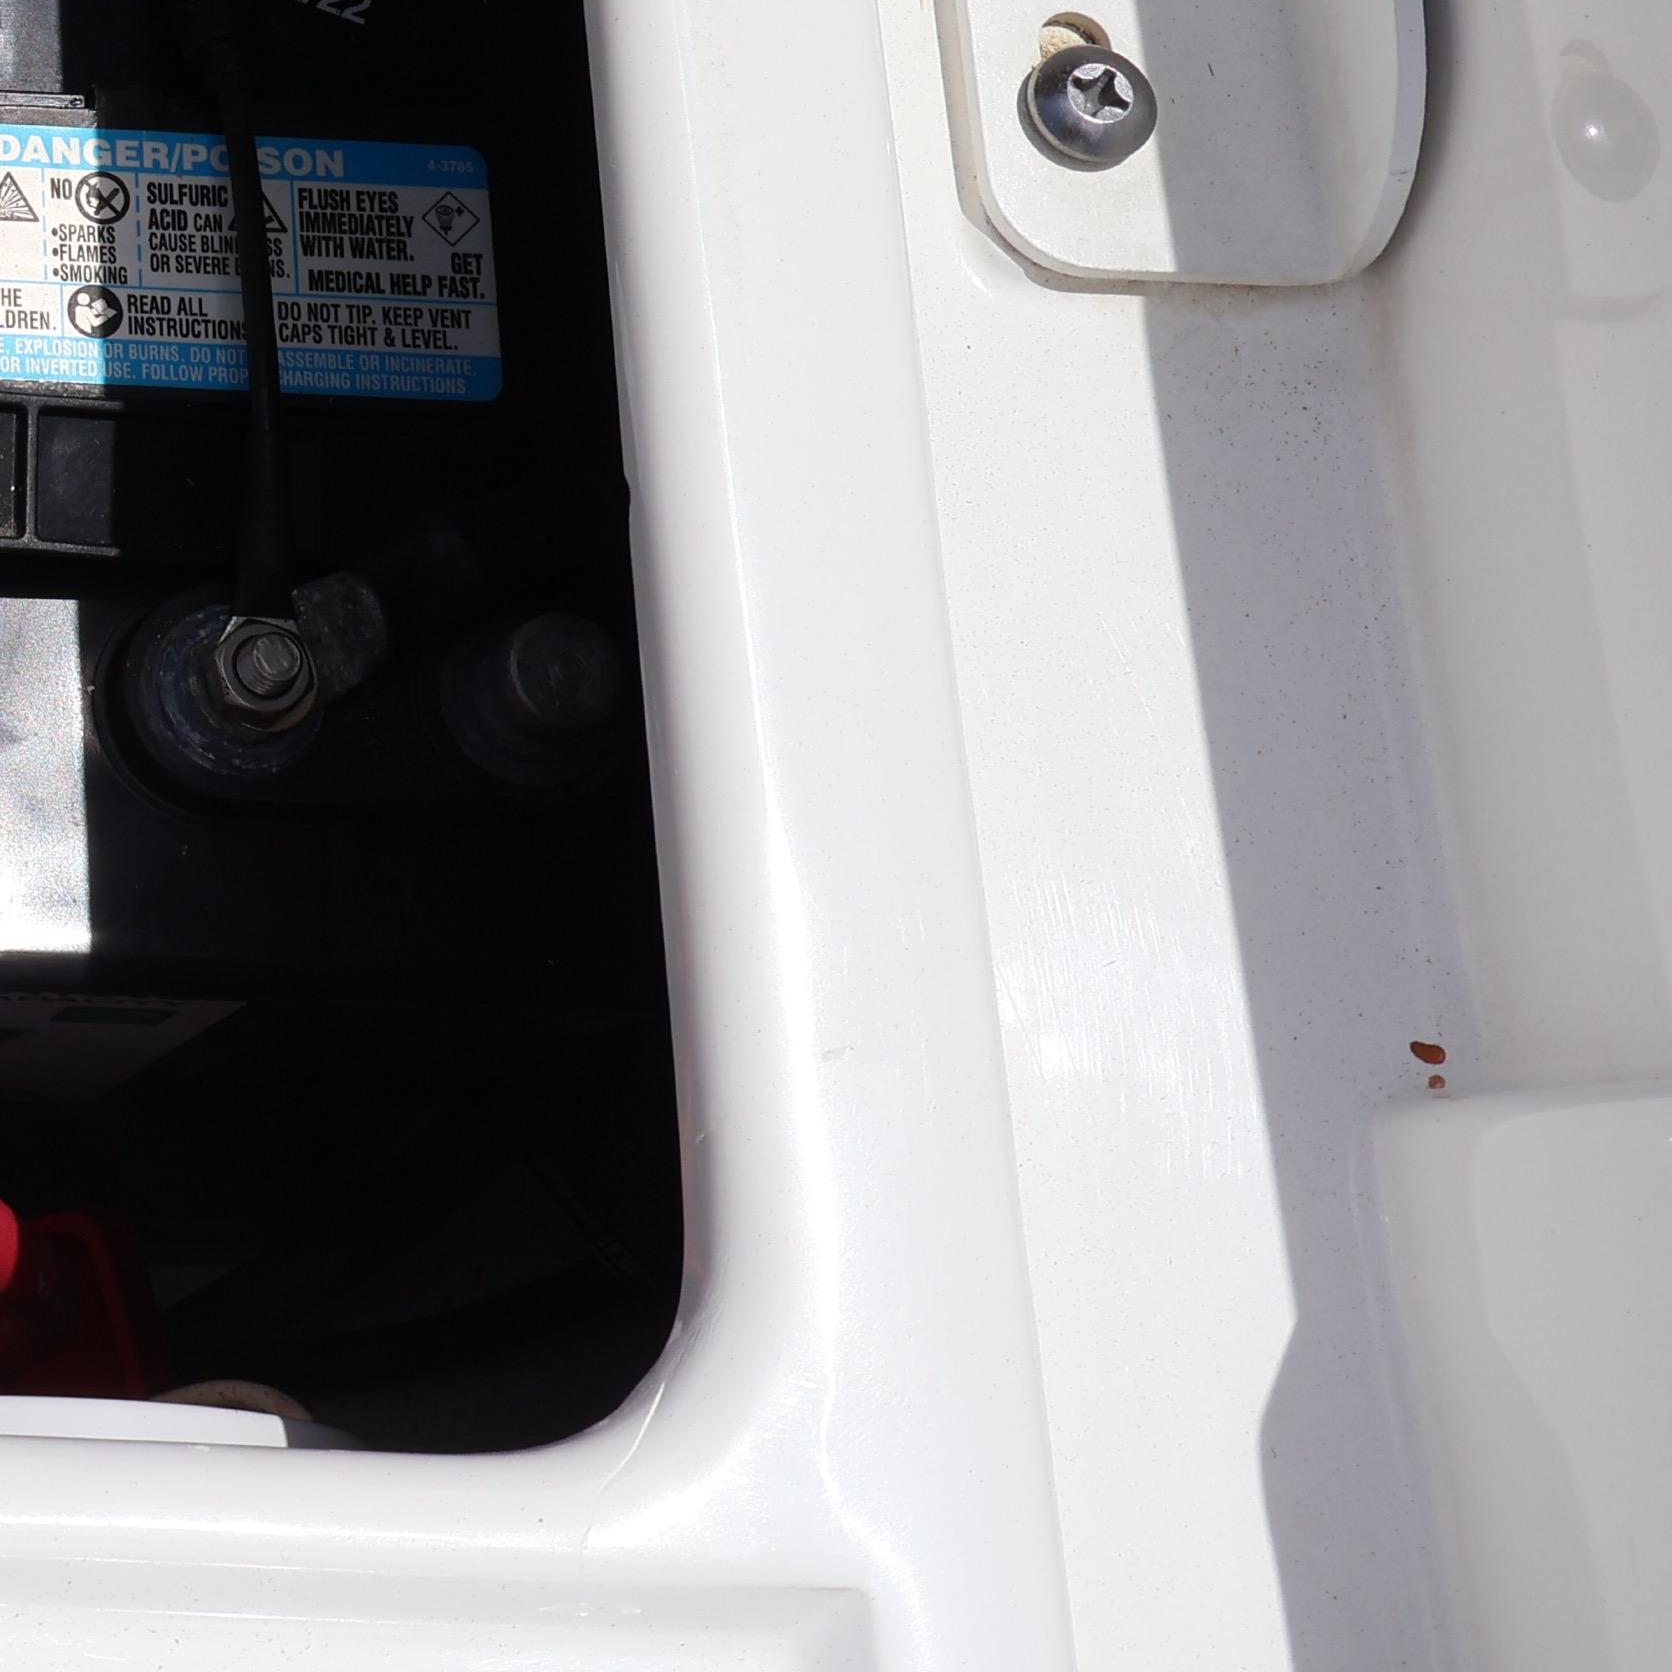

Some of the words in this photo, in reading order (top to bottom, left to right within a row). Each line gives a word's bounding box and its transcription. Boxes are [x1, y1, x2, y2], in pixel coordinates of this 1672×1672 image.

[50, 177, 72, 200] NO
[146, 182, 229, 208] SULFURIC
[297, 187, 351, 212] FLUSH
[355, 190, 399, 214] EYES
[148, 208, 188, 231] ACID
[193, 210, 223, 233] CAN
[298, 211, 414, 238] IMMEDIATELY
[148, 232, 197, 253] CAUSE
[299, 234, 345, 259] WITH
[349, 236, 415, 262] WATER.
[149, 253, 170, 273] OR
[175, 255, 229, 276] SEVERE
[449, 252, 483, 276] GET
[308, 269, 385, 295] MEDICAL
[390, 273, 432, 298] HELP
[438, 276, 486, 300] FAST.
[127, 293, 171, 315] READ
[176, 295, 208, 317] ALL
[278, 301, 301, 322] DO
[306, 302, 340, 324] NOT
[346, 303, 376, 326] TIP.
[381, 305, 424, 327] KEEP
[428, 307, 472, 329] VENT
[278, 323, 323, 345] CAPS
[327, 325, 377, 347] TIGHT
[384, 328, 396, 347] &
[401, 330, 459, 350] LEVEL.
